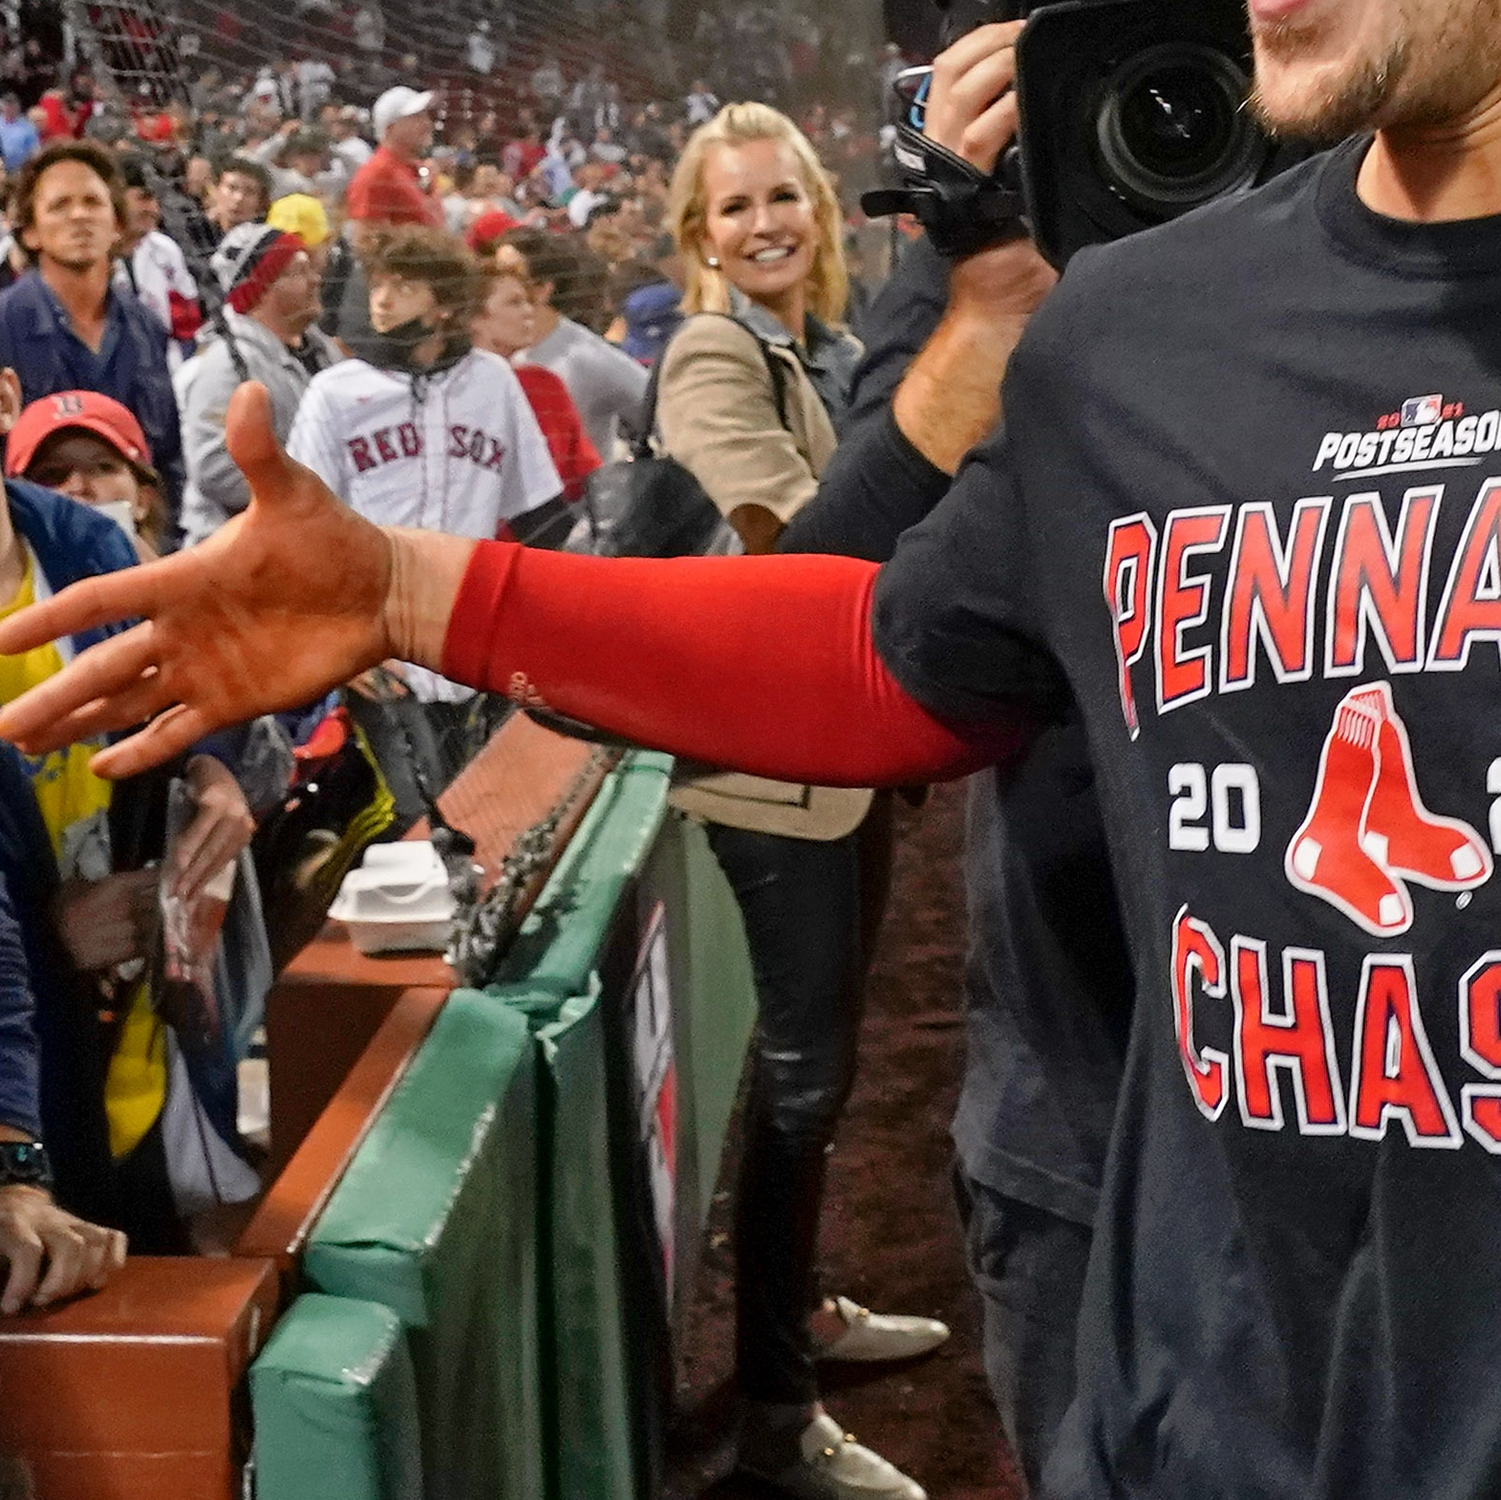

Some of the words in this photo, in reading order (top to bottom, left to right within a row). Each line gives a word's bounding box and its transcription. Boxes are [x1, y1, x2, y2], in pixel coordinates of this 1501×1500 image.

[347, 422, 423, 474] RED
[448, 425, 505, 474] SOX
[1168, 761, 1262, 854] 20
